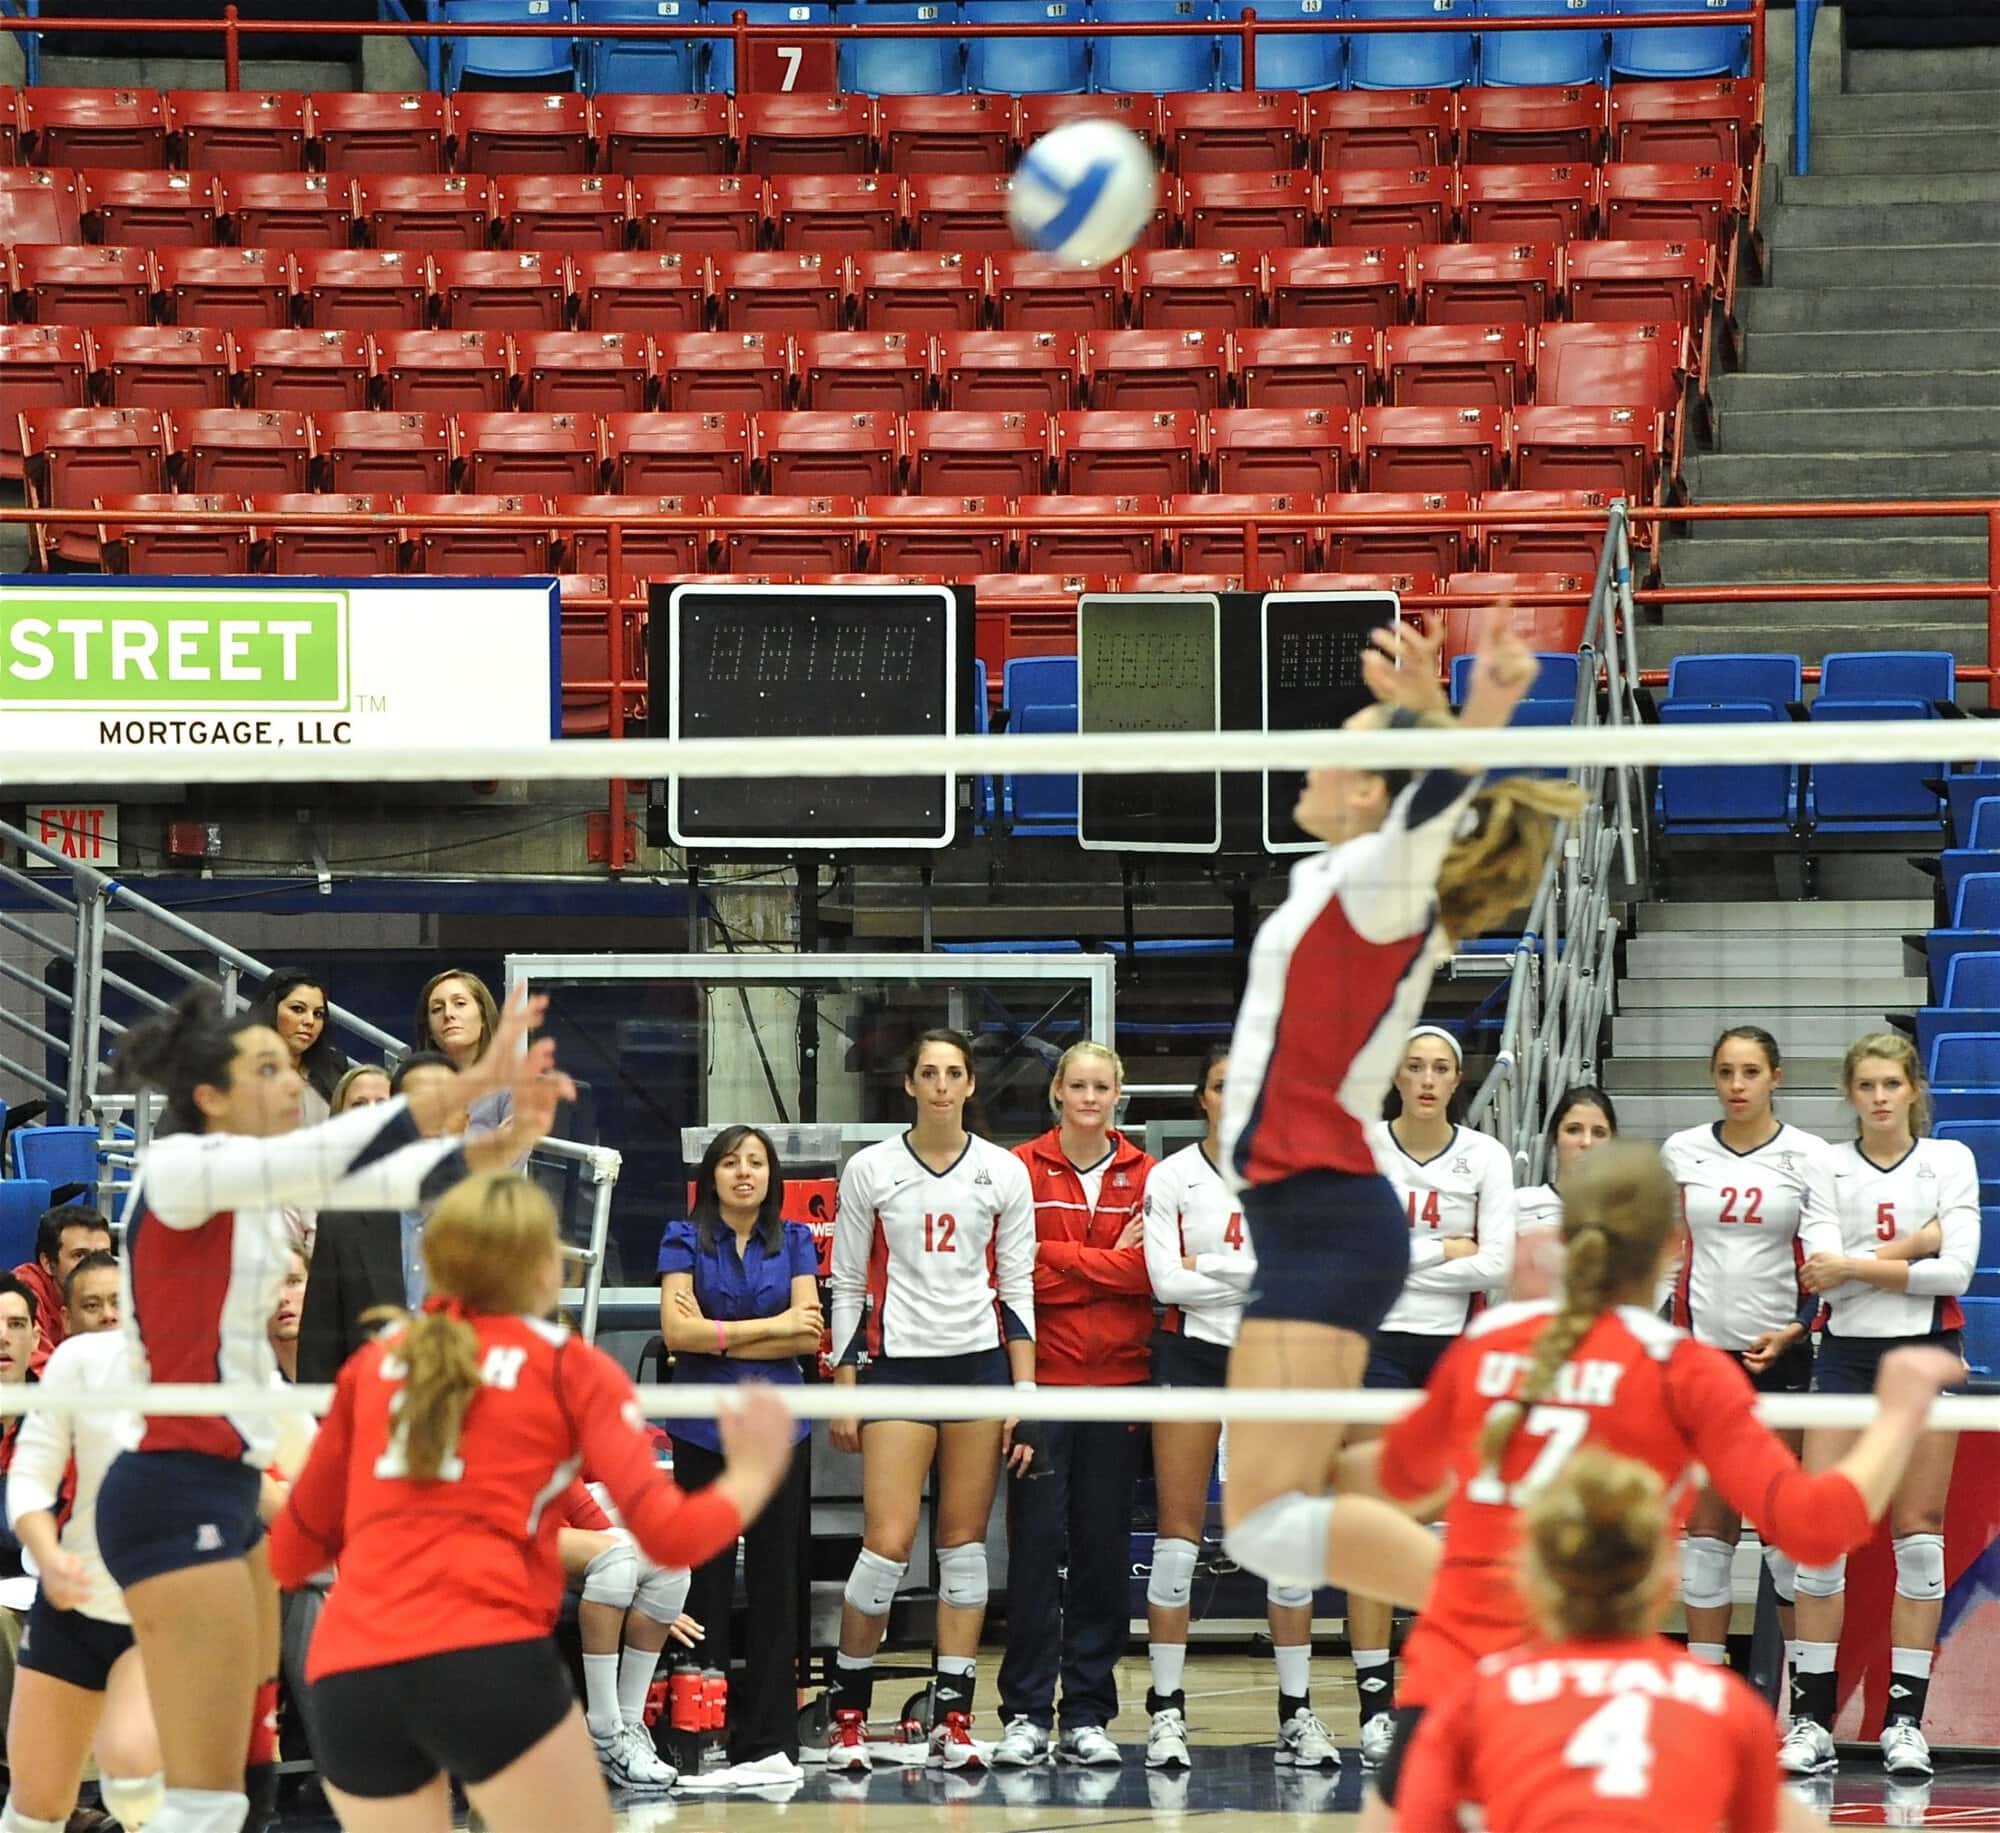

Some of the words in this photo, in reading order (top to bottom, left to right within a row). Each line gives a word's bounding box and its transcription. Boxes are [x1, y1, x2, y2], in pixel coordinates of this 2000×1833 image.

[665, 3, 672, 14] 8
[1052, 5, 1062, 15] 11
[1179, 3, 1190, 13] 12
[1306, 0, 1318, 11] 13
[1440, 0, 1451, 9] 14
[796, 11, 802, 19] 9
[922, 7, 934, 17] 10
[777, 47, 803, 92] 7
[693, 98, 699, 110] 7
[1118, 98, 1130, 109] 10
[1263, 96, 1275, 106] 11
[1414, 172, 1426, 182] 12
[1557, 169, 1567, 180] 13
[451, 179, 458, 189] 5
[589, 178, 595, 190] 6
[727, 179, 733, 190] 7
[1276, 176, 1288, 186] 11
[108, 250, 115, 262] 2
[1518, 247, 1530, 258] 12
[667, 255, 674, 266] 6
[807, 255, 813, 266] 7
[44, 329, 49, 340] 1
[186, 331, 193, 343] 2
[1643, 326, 1656, 338] 12
[469, 335, 476, 347] 4
[892, 335, 898, 347] 7
[121, 411, 126, 422] 1
[266, 414, 273, 425] 2
[409, 416, 416, 428] 3
[560, 417, 567, 428] 4
[710, 416, 718, 428] 5
[858, 416, 865, 427] 6
[1012, 416, 1018, 427] 7
[1161, 415, 1168, 426] 8
[1316, 413, 1323, 424] 9
[204, 498, 209, 510] 1
[356, 499, 363, 511] 2
[667, 499, 674, 510] 4
[1124, 499, 1130, 511] 7
[1278, 497, 1286, 510] 8
[1433, 497, 1440, 509] 9
[1588, 493, 1600, 505] 10
[506, 500, 514, 511] 3
[817, 501, 824, 512] 5
[969, 500, 977, 512] 6
[599, 579, 606, 591] 3
[1234, 578, 1240, 591] 7
[1399, 577, 1406, 589] 8
[1568, 578, 1575, 590] 9
[9, 618, 313, 681] STREET
[356, 694, 387, 713] TM
[100, 721, 285, 747] MORTGAGE,
[298, 721, 352, 745] LLC
[40, 809, 105, 860] EXIT
[1407, 1191, 1441, 1229] 14
[1719, 1187, 1764, 1225] 22
[1876, 1203, 1897, 1241] 5
[925, 1213, 956, 1253] 12
[1224, 1212, 1244, 1250] 4
[1467, 1400, 1590, 1506] 17
[1508, 1659, 1727, 1716] UTAH
[1563, 1690, 1656, 1798] 4
